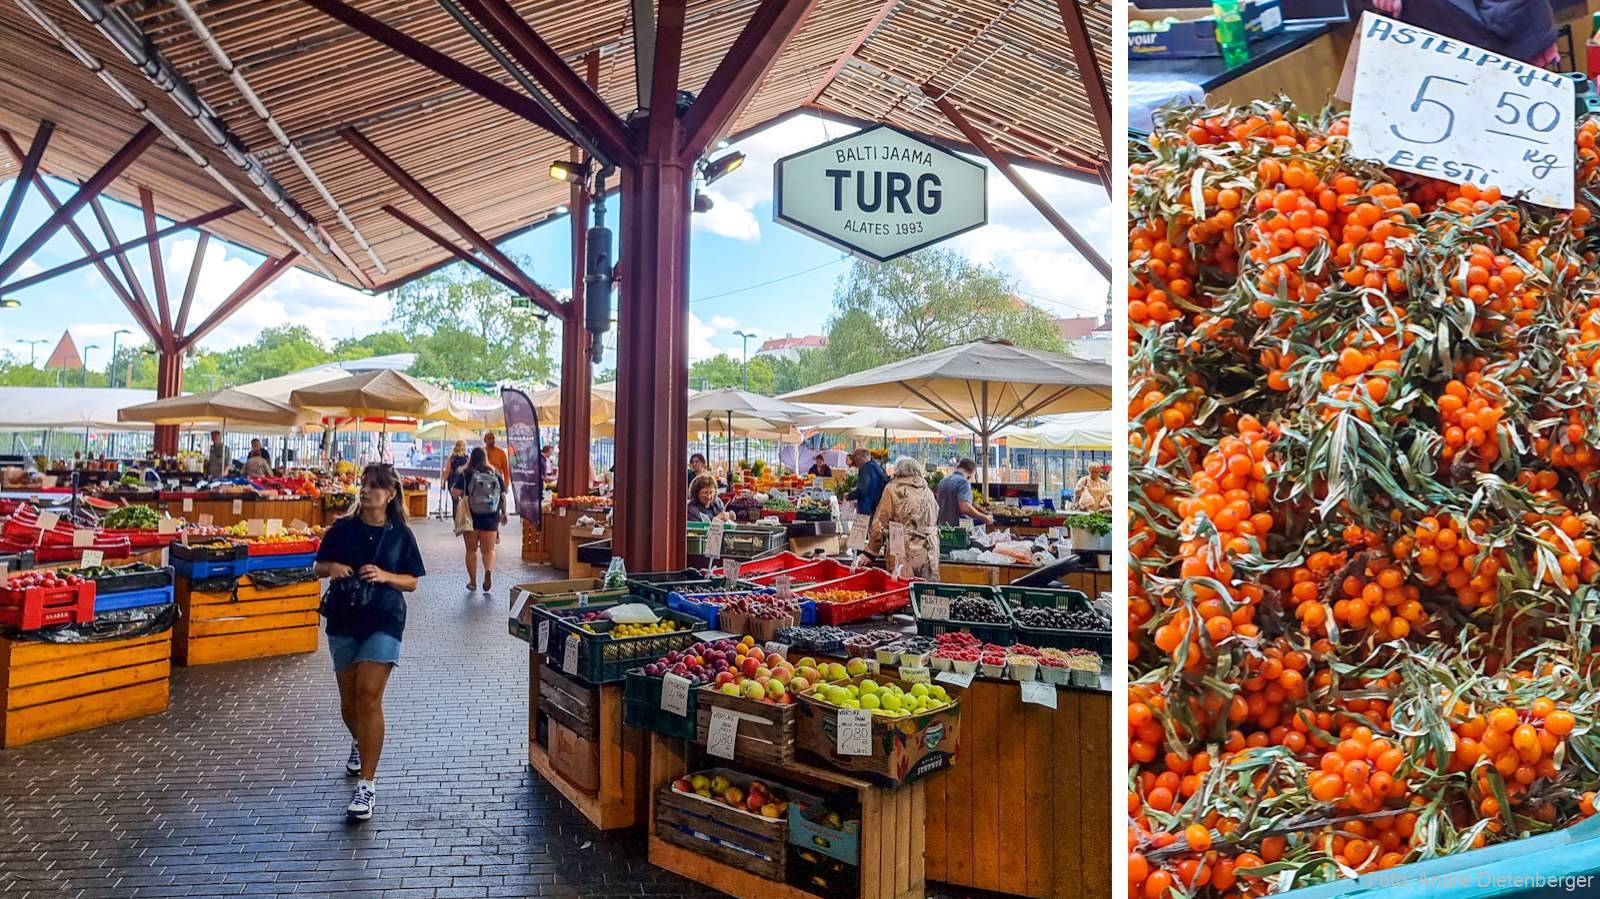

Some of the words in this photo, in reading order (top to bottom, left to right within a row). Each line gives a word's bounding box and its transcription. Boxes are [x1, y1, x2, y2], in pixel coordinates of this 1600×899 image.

[1390, 75, 1469, 144] 5
[1494, 91, 1560, 132] 50
[836, 146, 878, 164] BALTI
[882, 146, 932, 167] JAAMA
[1522, 149, 1568, 180] kg
[825, 168, 942, 215] TURG
[843, 219, 890, 235] ALATES
[895, 221, 924, 235] 1993
